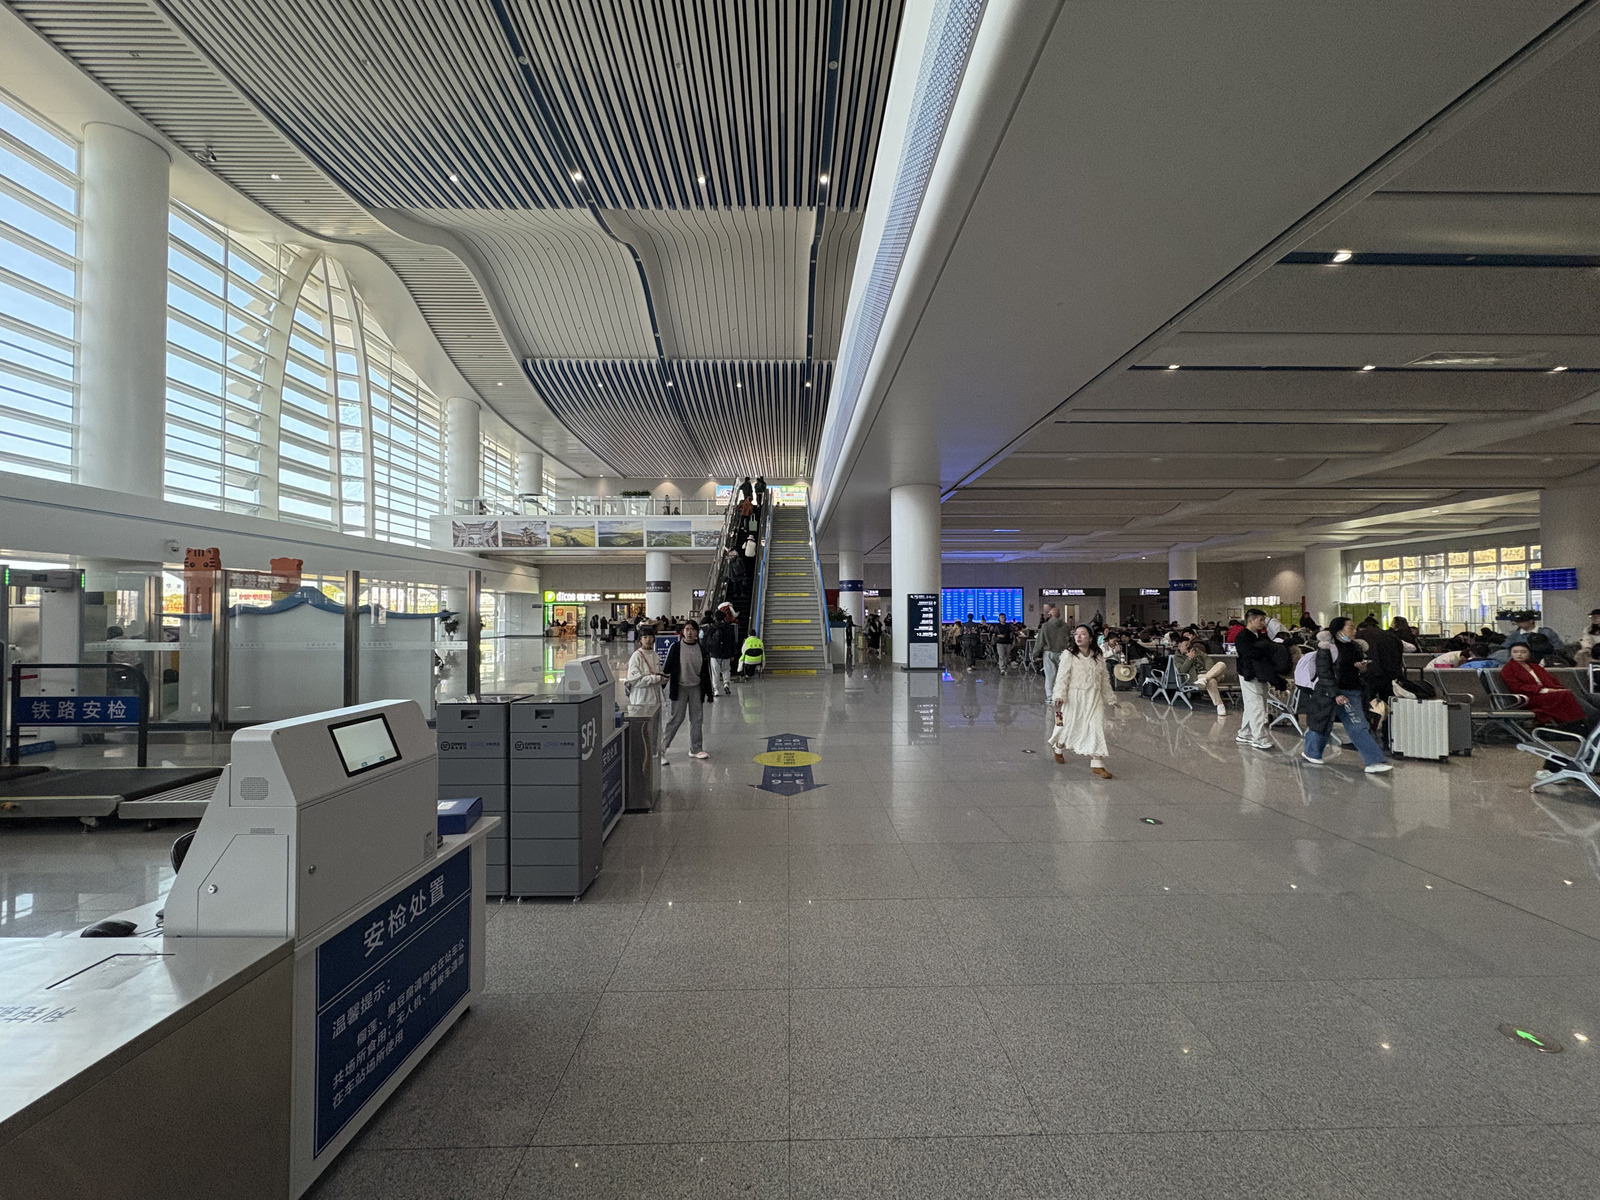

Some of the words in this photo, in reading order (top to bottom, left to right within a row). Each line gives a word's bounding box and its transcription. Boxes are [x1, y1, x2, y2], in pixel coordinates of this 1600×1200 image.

[556, 592, 575, 601] dicos
[31, 700, 127, 719] 铁路安检
[363, 874, 446, 958] 安检处置
[332, 1029, 404, 1110] 在车站场所使用
